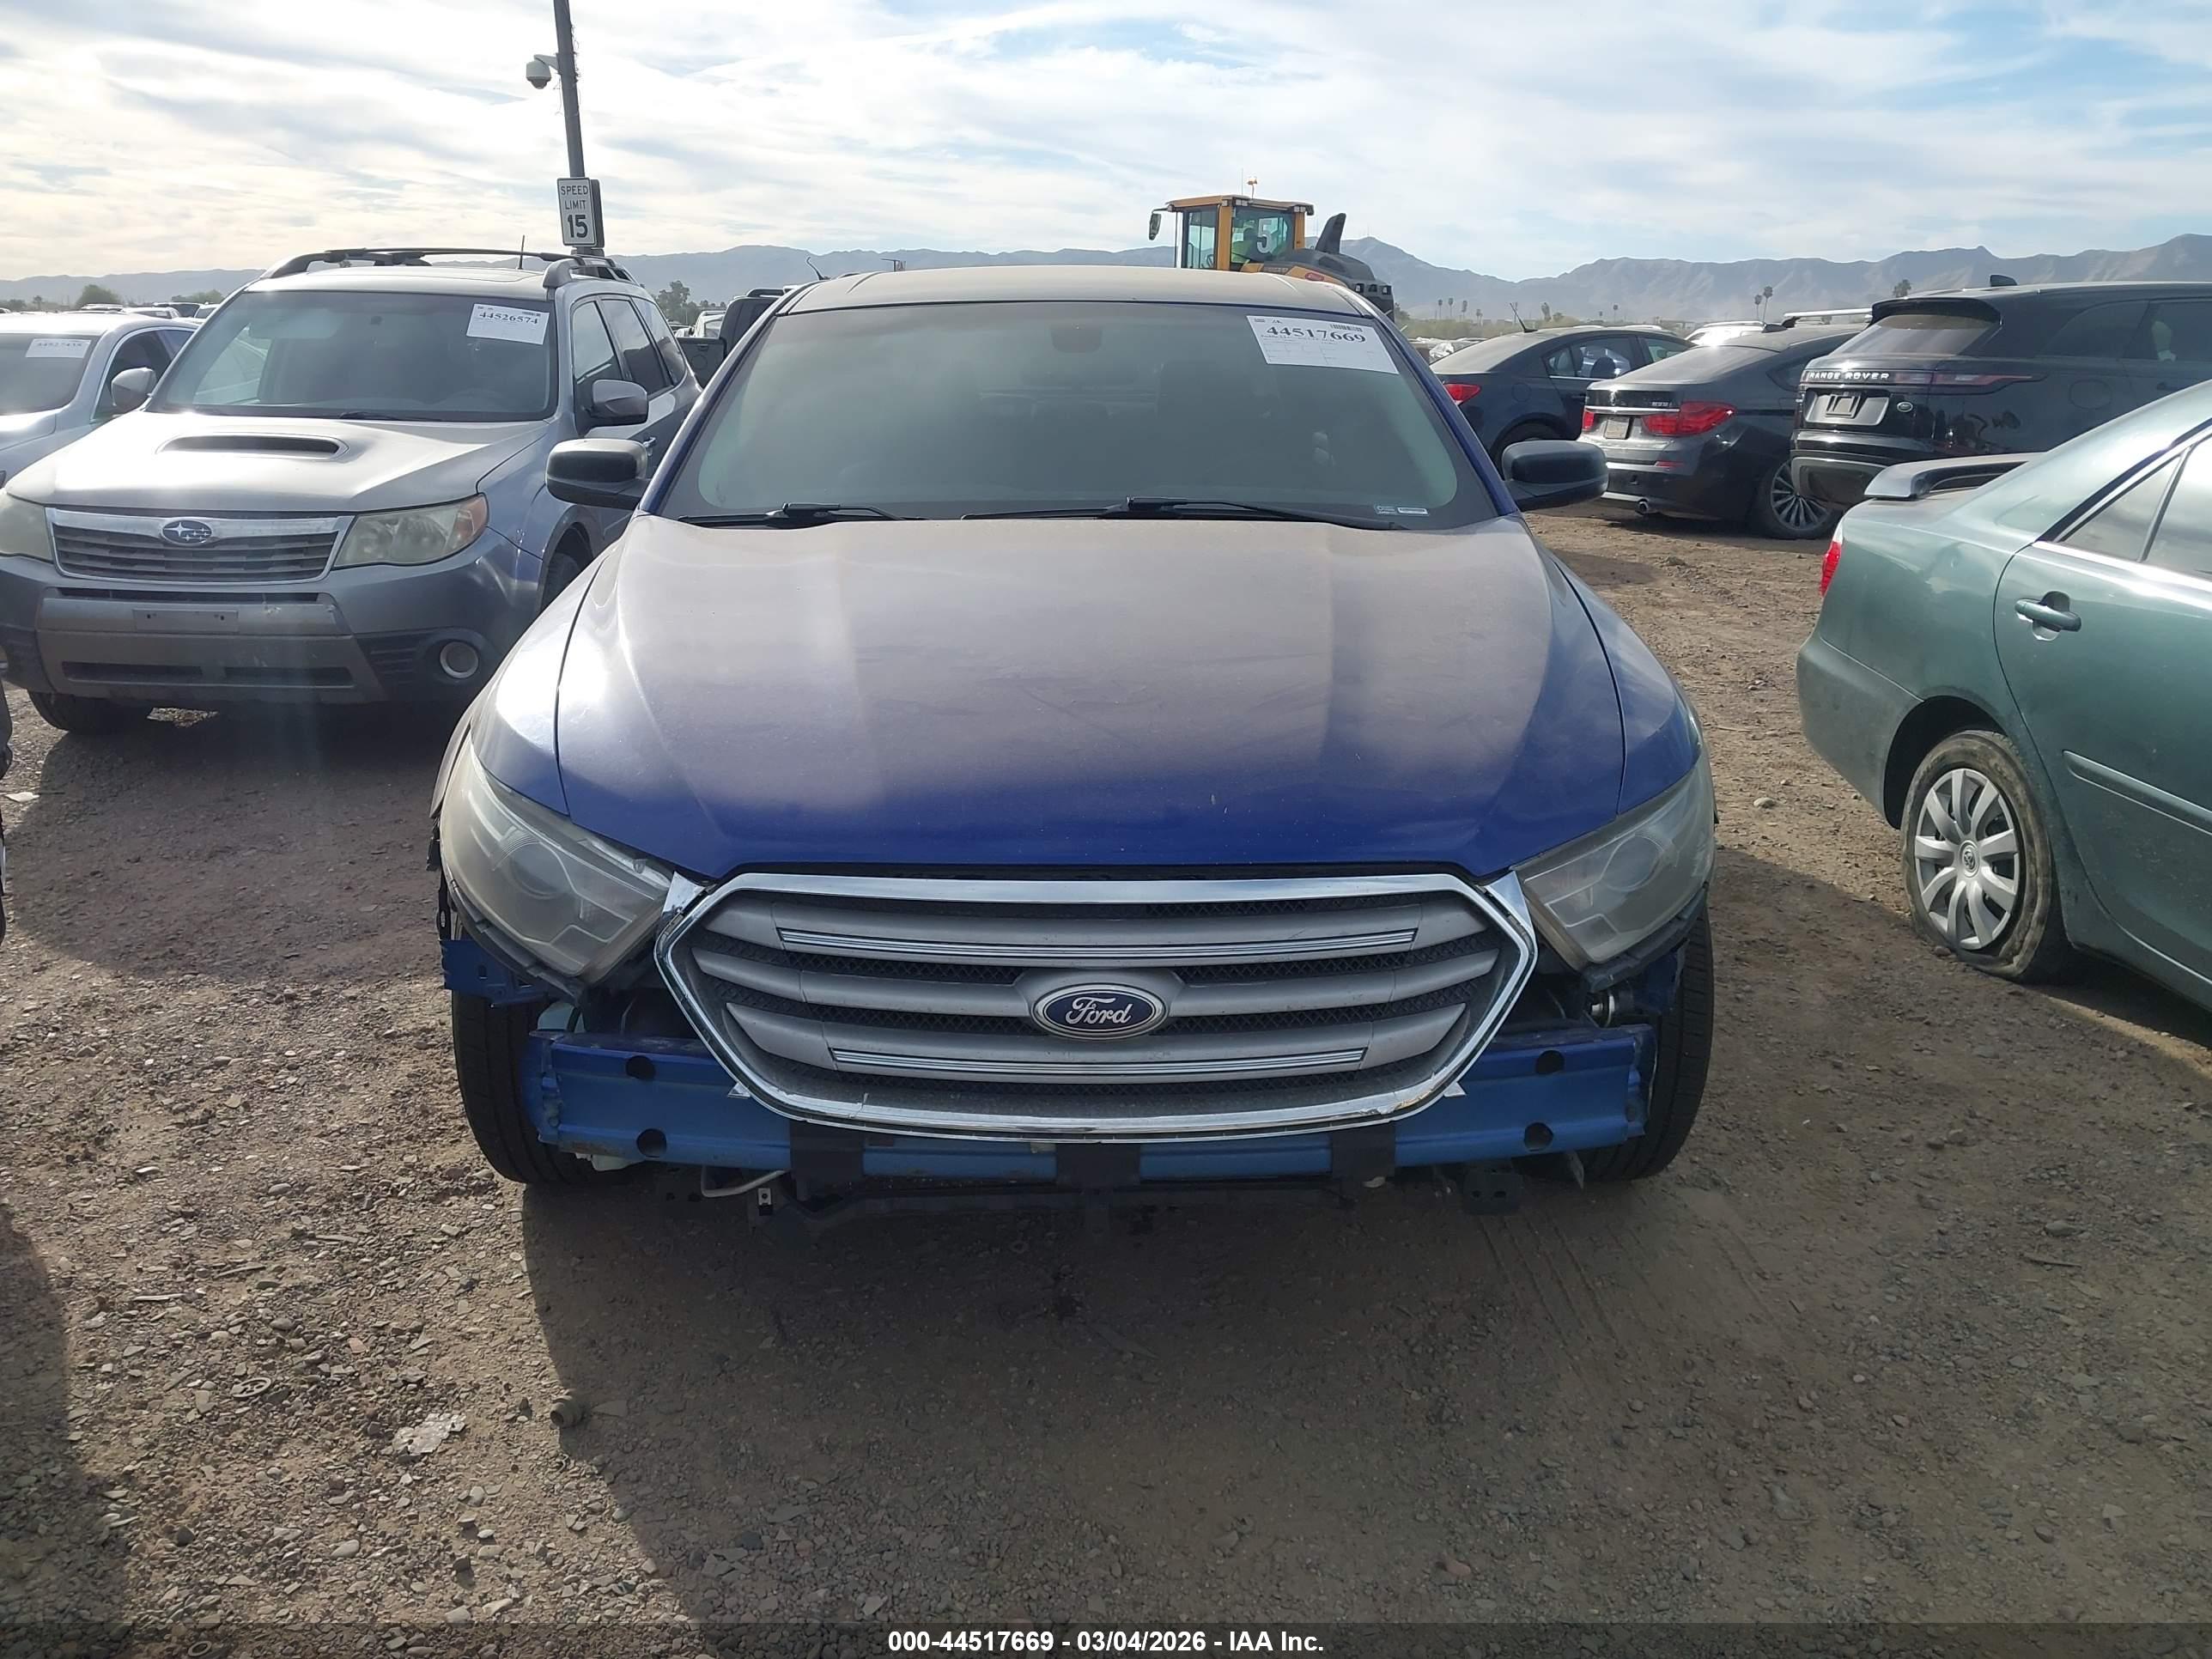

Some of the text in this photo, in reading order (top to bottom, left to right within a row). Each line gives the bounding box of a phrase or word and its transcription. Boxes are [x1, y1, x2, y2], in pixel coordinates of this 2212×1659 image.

[560, 185, 589, 196] SPEED
[564, 199, 586, 210] LIMIT
[567, 214, 588, 239] 15
[1256, 217, 1273, 254] 5
[479, 312, 538, 325] 44526574
[1267, 326, 1366, 343] 44517669
[1844, 372, 1890, 380] ROVER
[1065, 996, 1133, 1024] Ford
